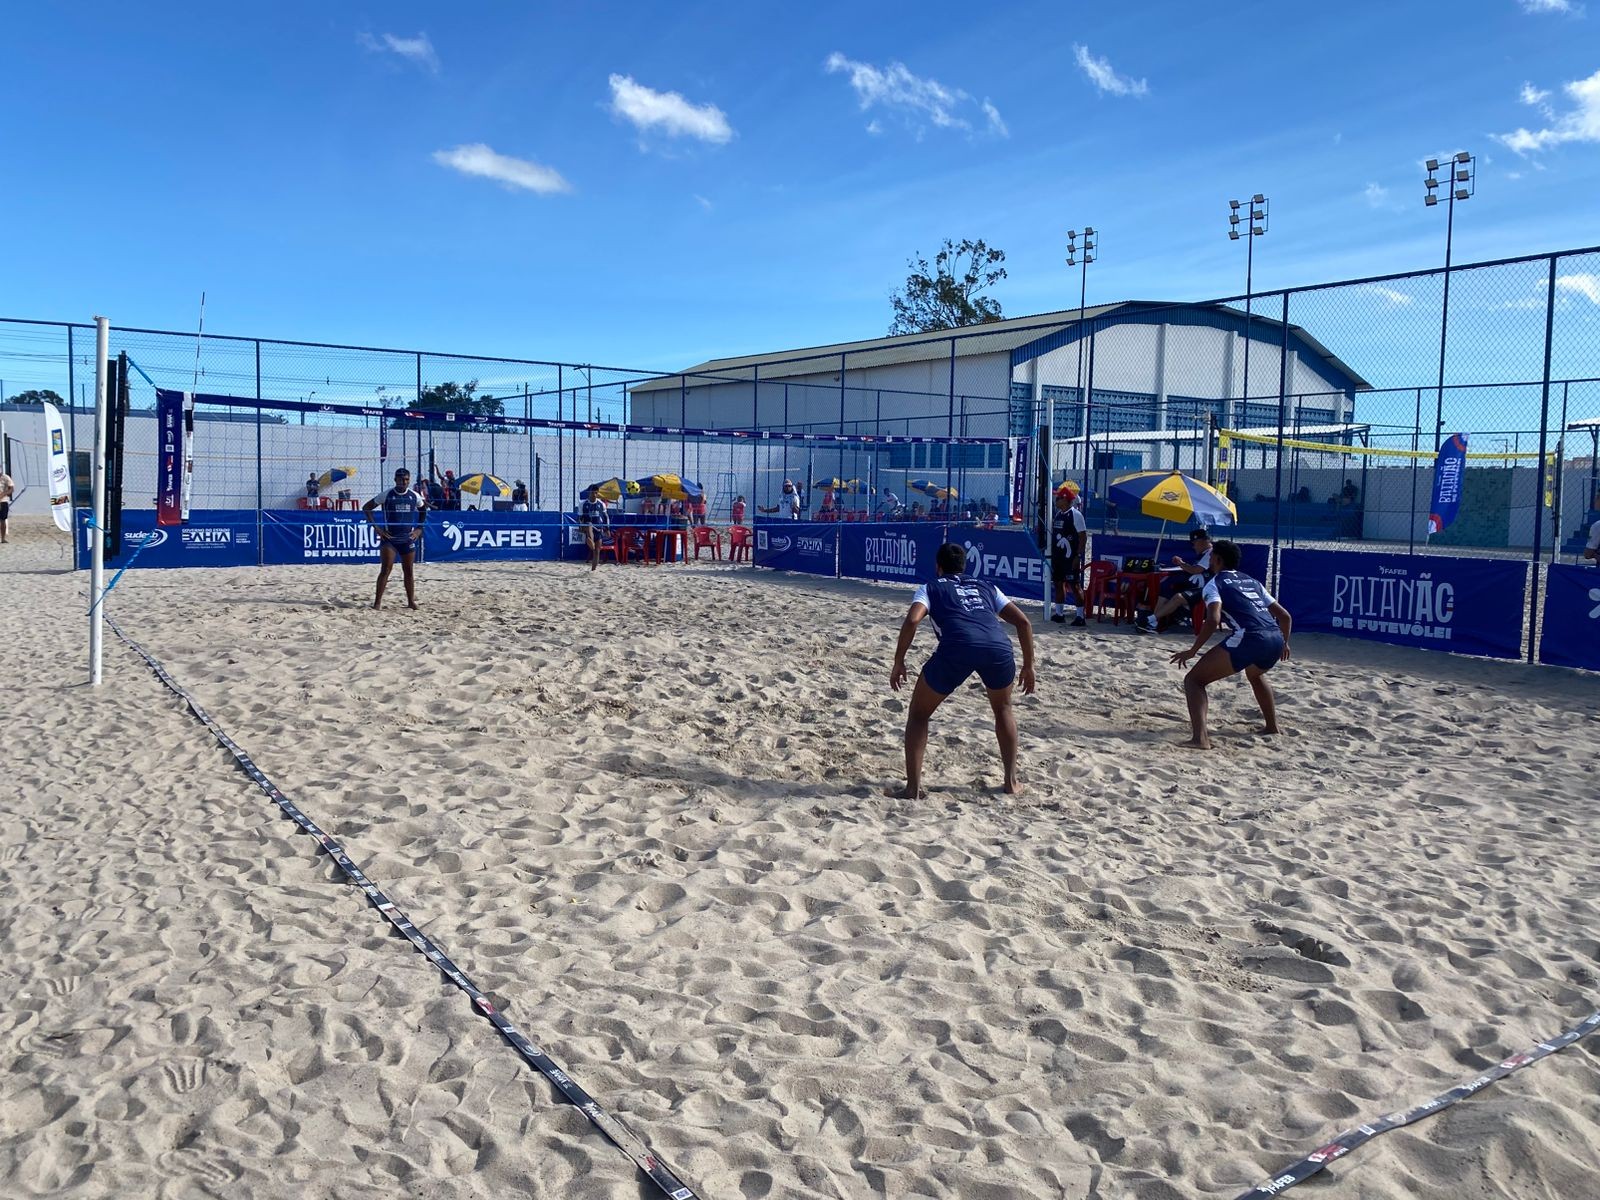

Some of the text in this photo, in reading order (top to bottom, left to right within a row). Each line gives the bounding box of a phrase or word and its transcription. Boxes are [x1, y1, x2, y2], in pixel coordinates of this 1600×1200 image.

[181, 532, 231, 543] BAHIA
[303, 519, 381, 549] BAIANÃO
[463, 529, 543, 548] FAFEB
[321, 548, 381, 557] FUTEVÔLEI
[797, 540, 822, 551] BAHIA
[865, 534, 916, 566] BAIANÃO
[865, 564, 916, 576] DE FUTEVÔLEI
[982, 553, 1046, 582] FAFE
[1141, 559, 1150, 568] 5
[1384, 568, 1408, 576] FAFEB
[1332, 572, 1455, 623] BAIANÃO
[1332, 616, 1453, 640] DE FUTEVÔLEI
[1268, 1174, 1296, 1193] FAFEB
